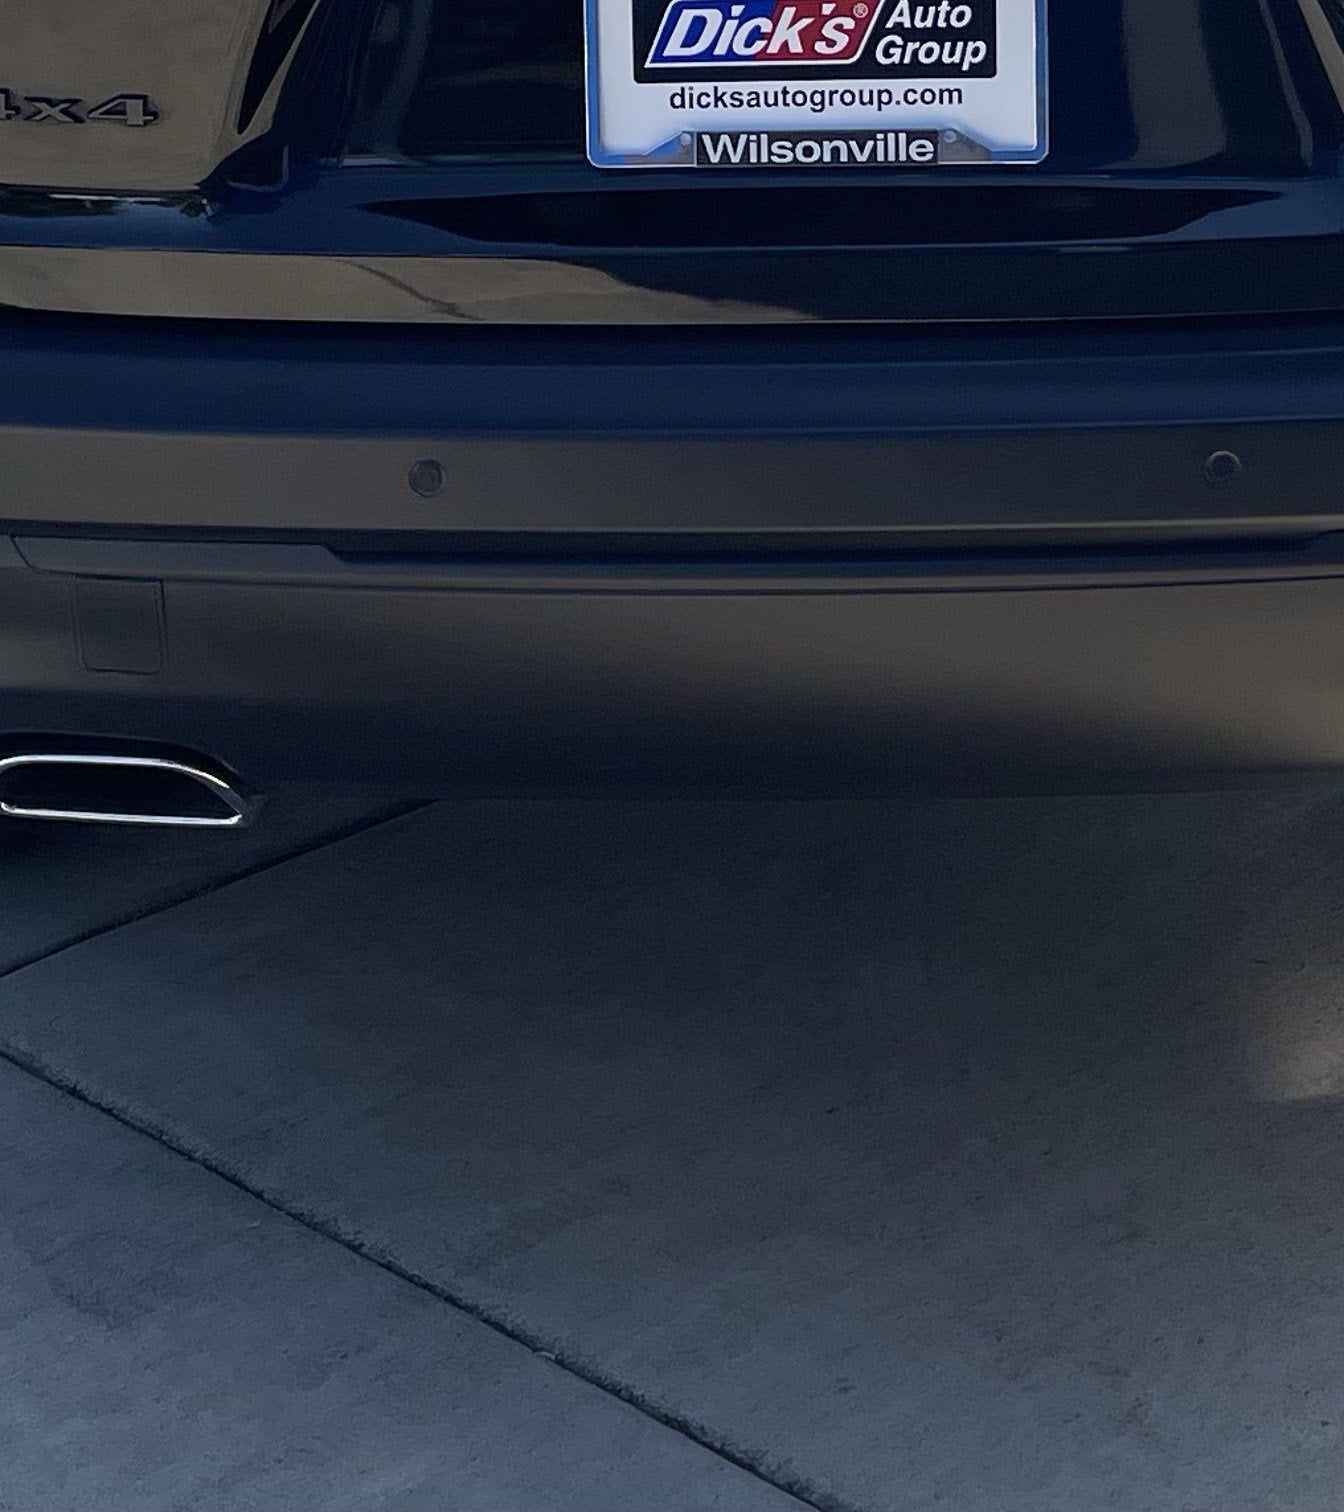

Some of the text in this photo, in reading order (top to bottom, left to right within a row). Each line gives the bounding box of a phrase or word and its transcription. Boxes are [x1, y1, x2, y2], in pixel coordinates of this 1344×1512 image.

[886, 0, 973, 29] Auto
[875, 35, 987, 71] Group
[669, 85, 964, 113] dicksautogroup.com
[701, 132, 935, 164] Wilsonville
